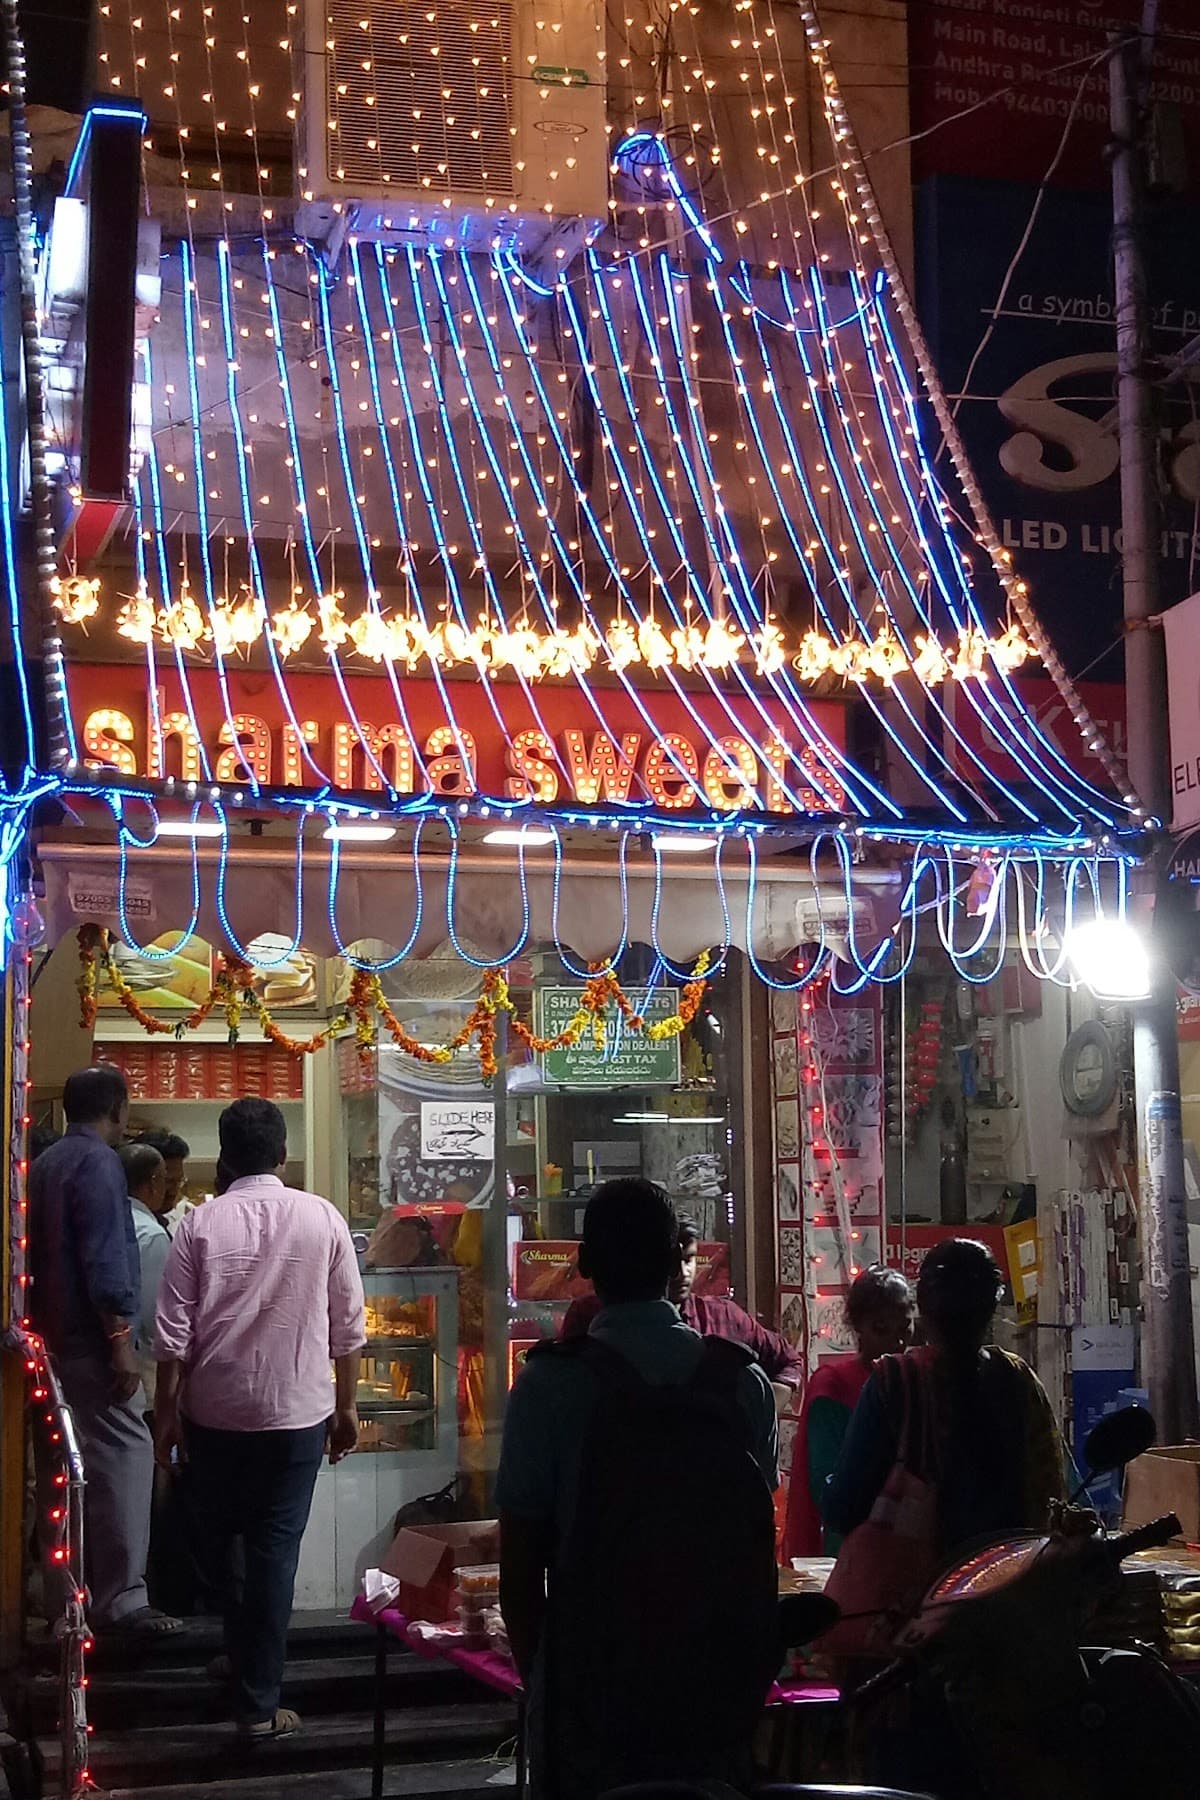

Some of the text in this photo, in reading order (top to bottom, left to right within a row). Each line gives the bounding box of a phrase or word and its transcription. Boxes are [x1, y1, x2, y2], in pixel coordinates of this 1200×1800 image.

[934, 19, 986, 45] Main
[993, 28, 1052, 57] Road,
[934, 50, 1014, 80] Andhra
[1018, 294, 1033, 311] a
[1043, 294, 1118, 326] symb
[1002, 518, 1200, 560] LED LIT
[83, 685, 846, 813] sharma sweets
[550, 996, 671, 1009] SHAA EETS
[570, 1040, 630, 1051] COMPTON
[611, 1055, 632, 1064] GST
[633, 1055, 657, 1064] TAX
